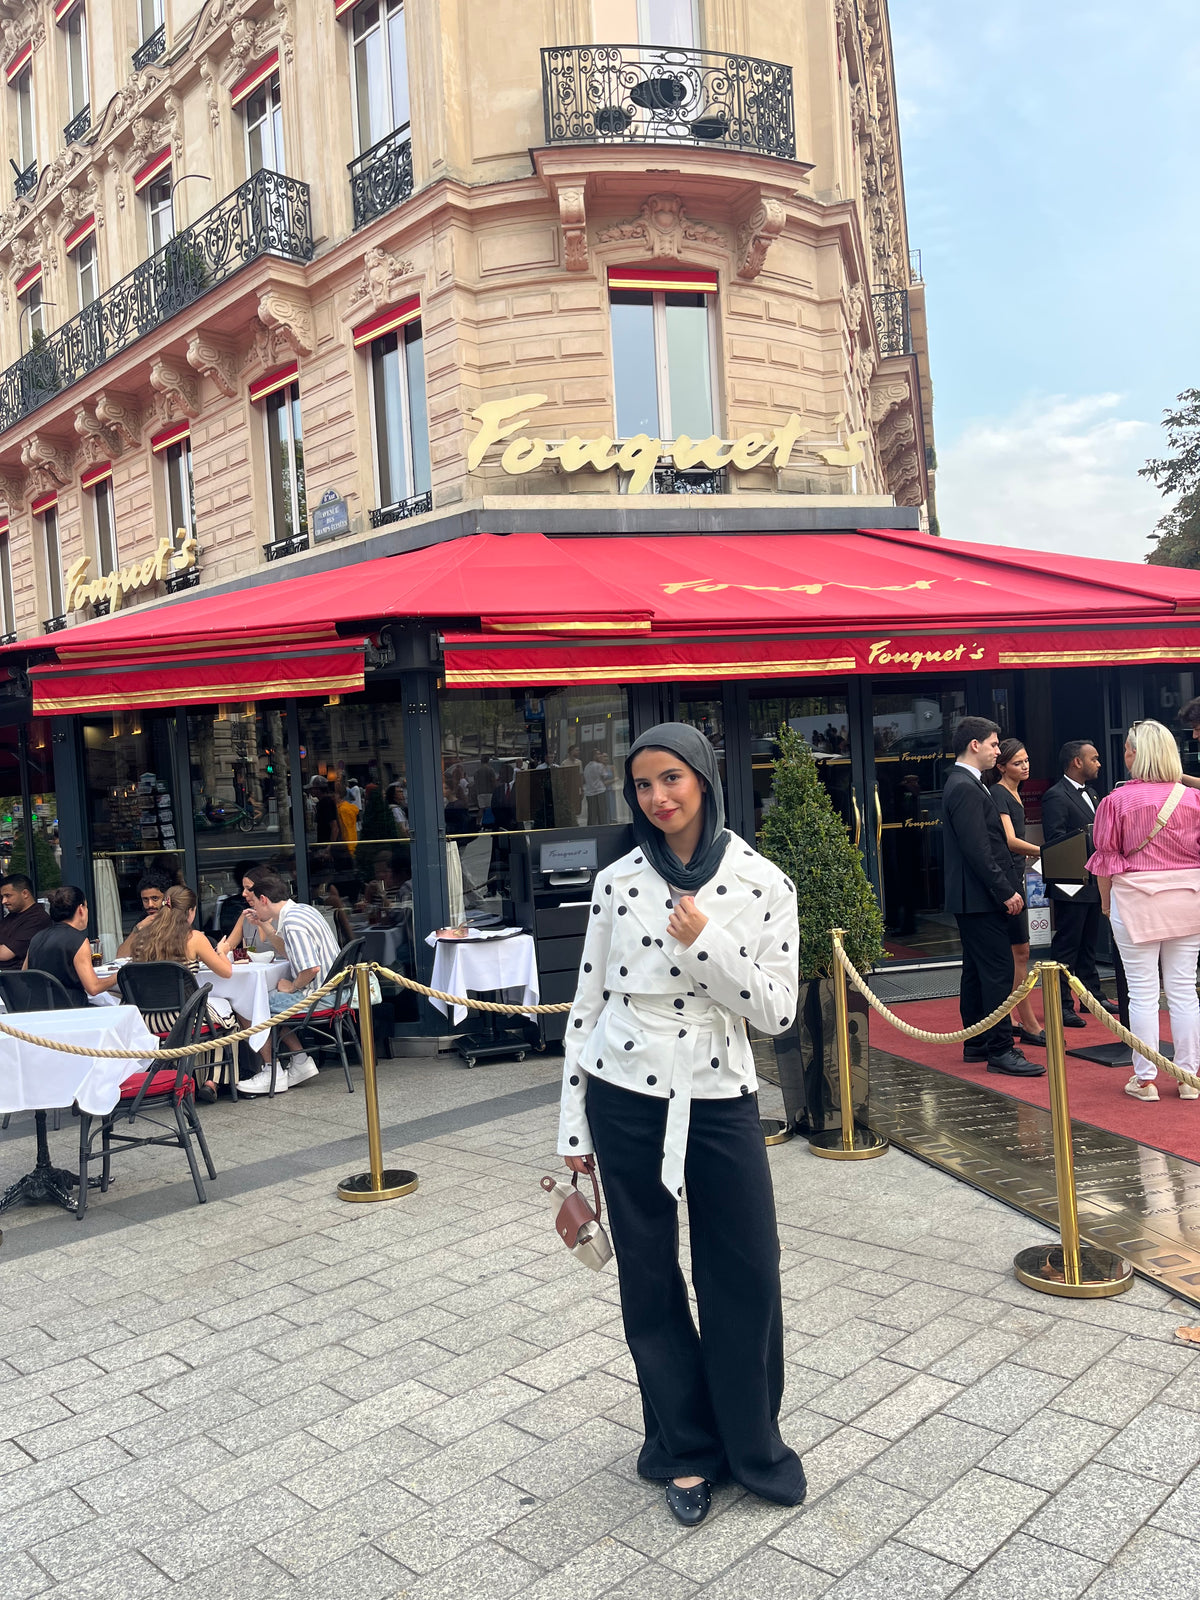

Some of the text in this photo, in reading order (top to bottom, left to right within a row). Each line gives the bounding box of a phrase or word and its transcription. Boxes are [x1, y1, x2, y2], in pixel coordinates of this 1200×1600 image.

[466, 393, 870, 494] Fouquet's
[65, 527, 198, 614] Fouquet's
[868, 639, 986, 671] Fouquet's
